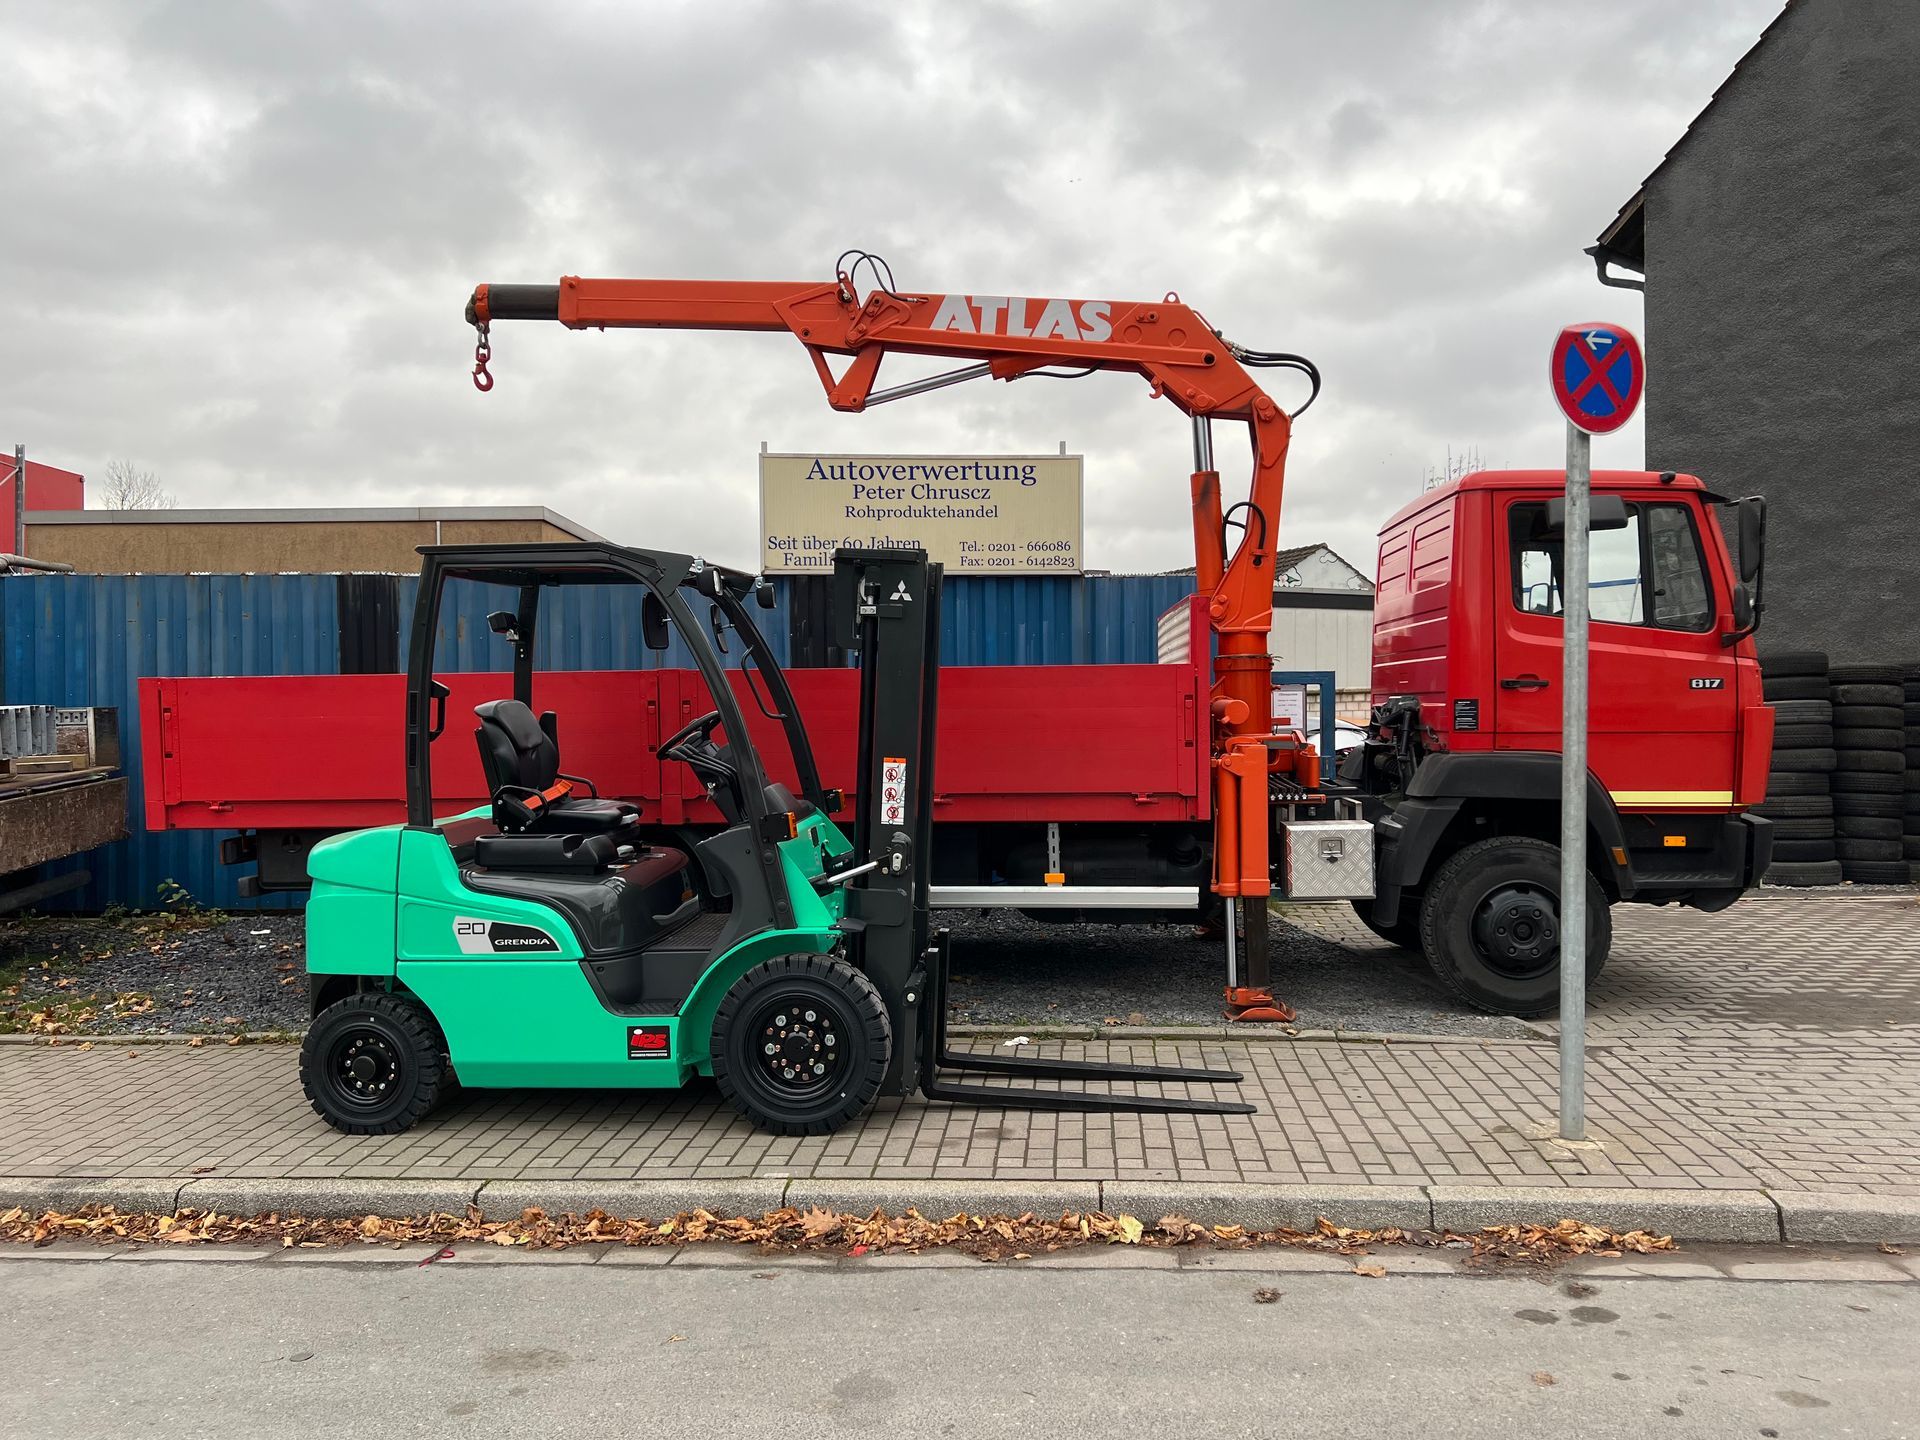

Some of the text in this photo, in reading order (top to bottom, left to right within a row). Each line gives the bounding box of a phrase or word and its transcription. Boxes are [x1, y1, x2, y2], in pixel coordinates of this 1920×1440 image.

[929, 294, 1113, 343] ATLAS
[806, 458, 1037, 486] Autoverwertung
[852, 484, 991, 500] Peter Chruscz
[845, 505, 999, 521] Rohproduktehandel
[768, 536, 921, 550] Seit über 60 Jahren
[959, 541, 984, 552] Tel.:
[987, 543, 1016, 552] 0201
[1026, 541, 1071, 552] 666086
[960, 556, 984, 567] Fax:
[987, 557, 1015, 567] 0201
[1026, 556, 1075, 568] 6142823
[1691, 679, 1721, 688] 817
[457, 923, 486, 935] 20
[494, 938, 551, 946] GRENDIA
